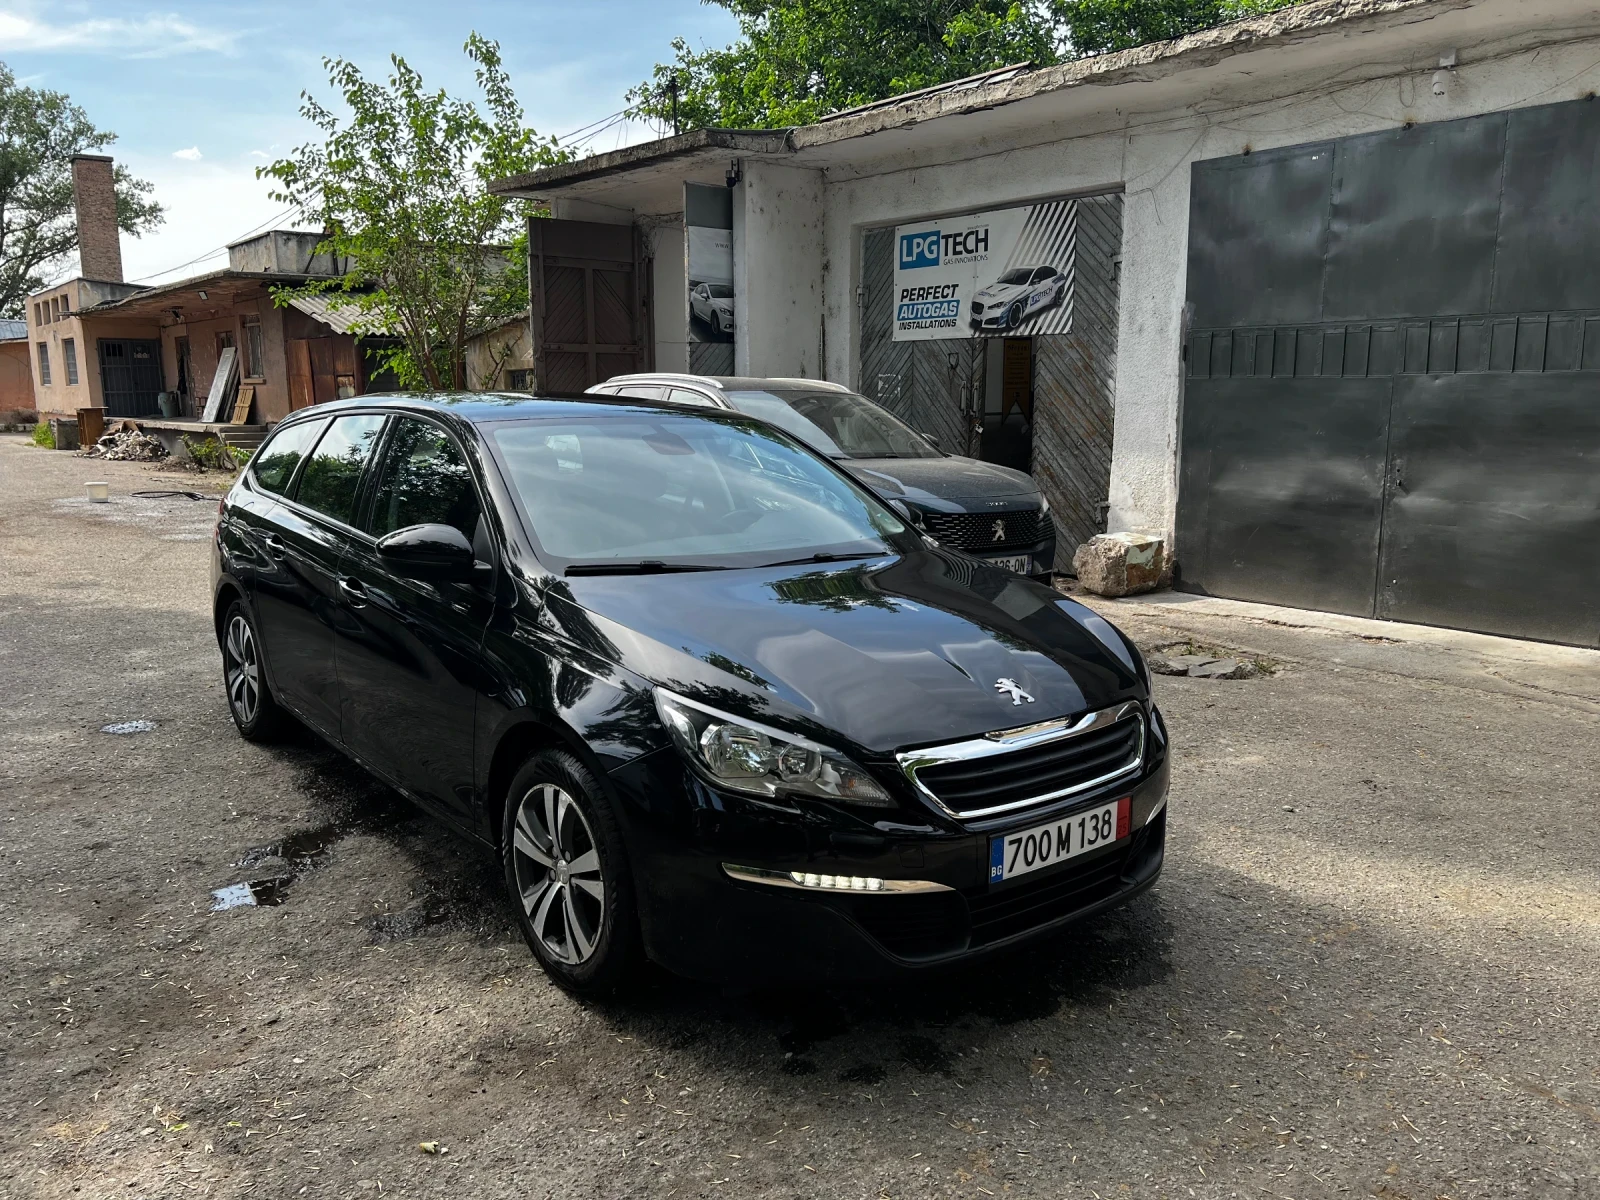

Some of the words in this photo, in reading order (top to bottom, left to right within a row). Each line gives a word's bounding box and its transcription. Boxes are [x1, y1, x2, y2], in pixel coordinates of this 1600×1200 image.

[943, 257, 954, 266] GAS
[955, 254, 989, 265] INNOVATIONS
[900, 284, 959, 302] PERFECT
[899, 302, 958, 319] AUTOGAS
[899, 319, 957, 330] INSTALLATIONS
[991, 865, 1003, 877] BG
[1007, 829, 1051, 873] 700
[1056, 822, 1071, 857] M
[1078, 809, 1112, 849] 138
